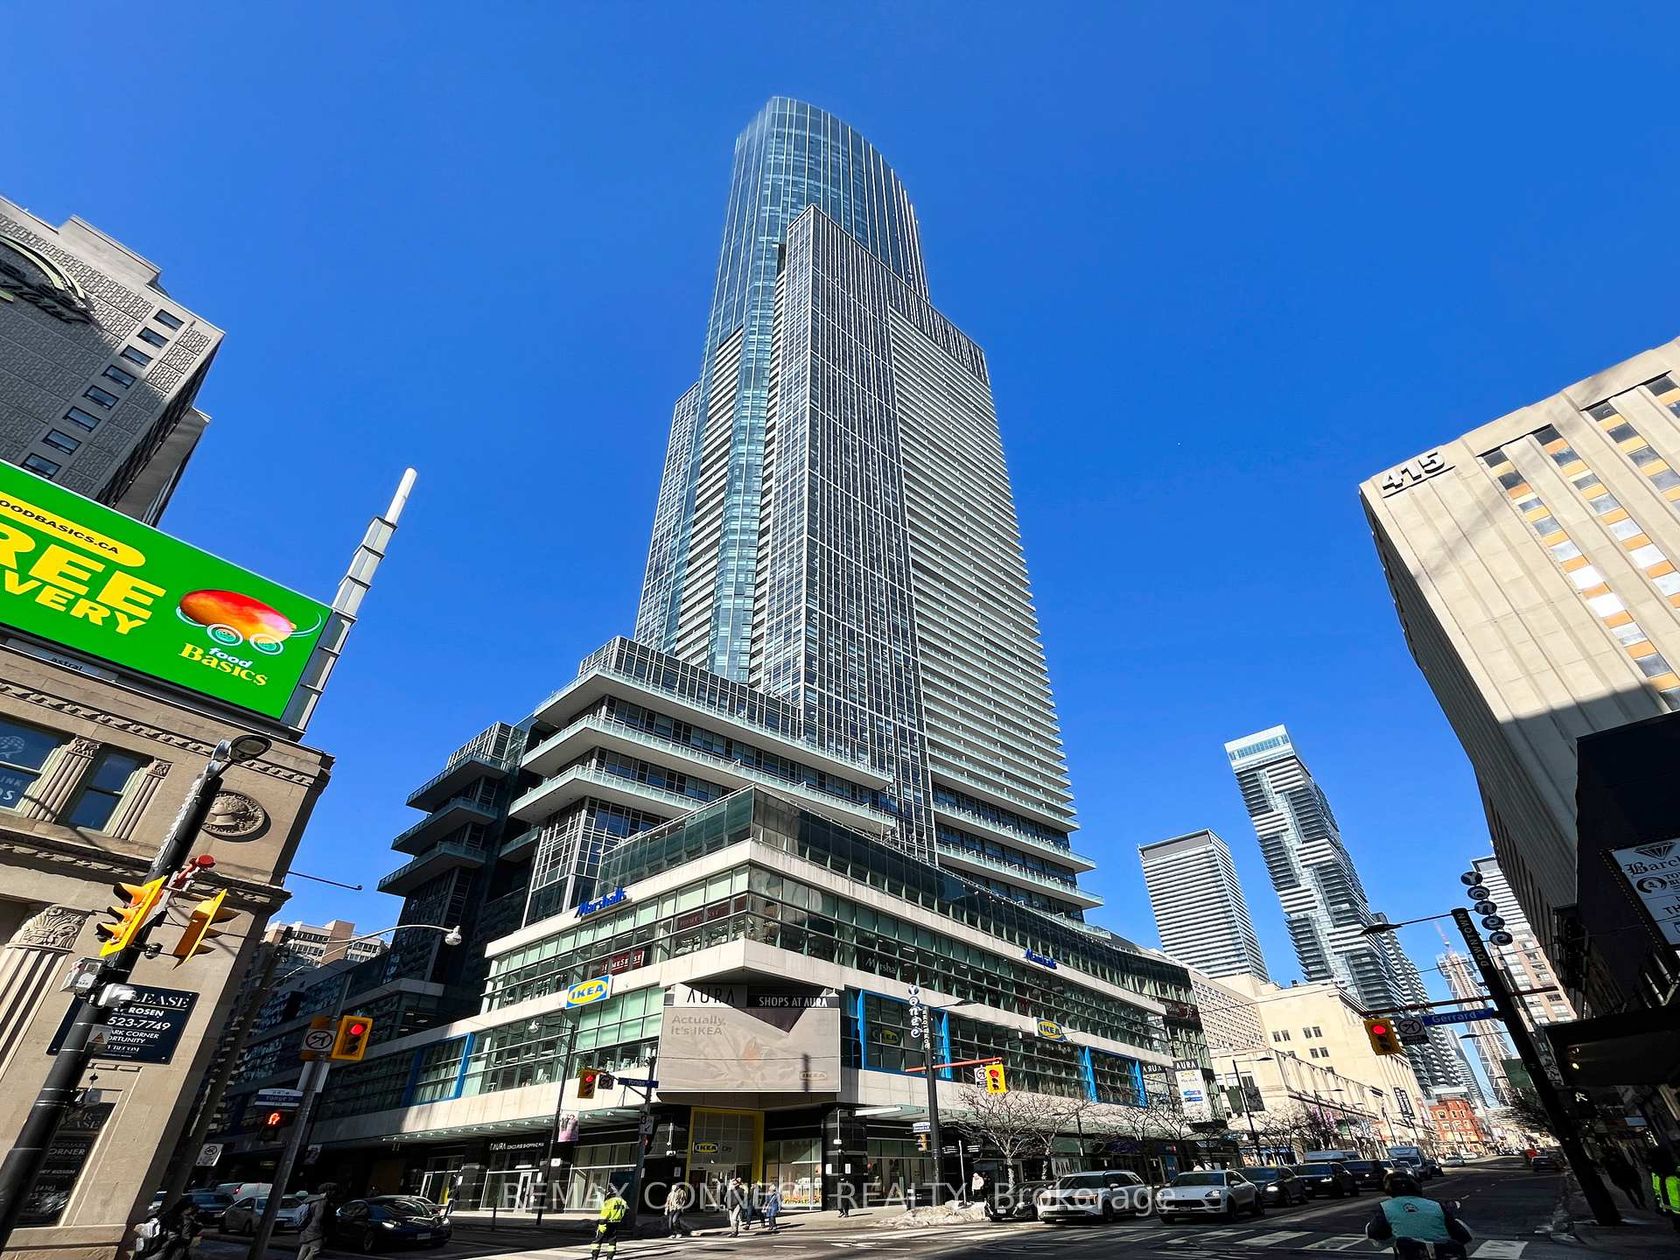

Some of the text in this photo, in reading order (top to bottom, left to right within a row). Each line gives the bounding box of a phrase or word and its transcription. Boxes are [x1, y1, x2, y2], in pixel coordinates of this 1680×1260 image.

[1382, 451, 1446, 490] 415
[178, 643, 268, 686] Basics
[208, 647, 253, 668] food
[1456, 912, 1489, 967] DOWNTOWN
[571, 984, 603, 999] IKEA
[686, 988, 736, 1004] AURA
[759, 996, 828, 1008] SHOPS AT AURA
[128, 1007, 165, 1017] ROSEN
[1431, 1009, 1478, 1023] Gerrard
[107, 1016, 171, 1031] 523-7749
[671, 1015, 727, 1027] Actually,
[126, 1030, 160, 1039] CORNER
[694, 1026, 722, 1035] IKEA
[1176, 1061, 1196, 1070] AURA
